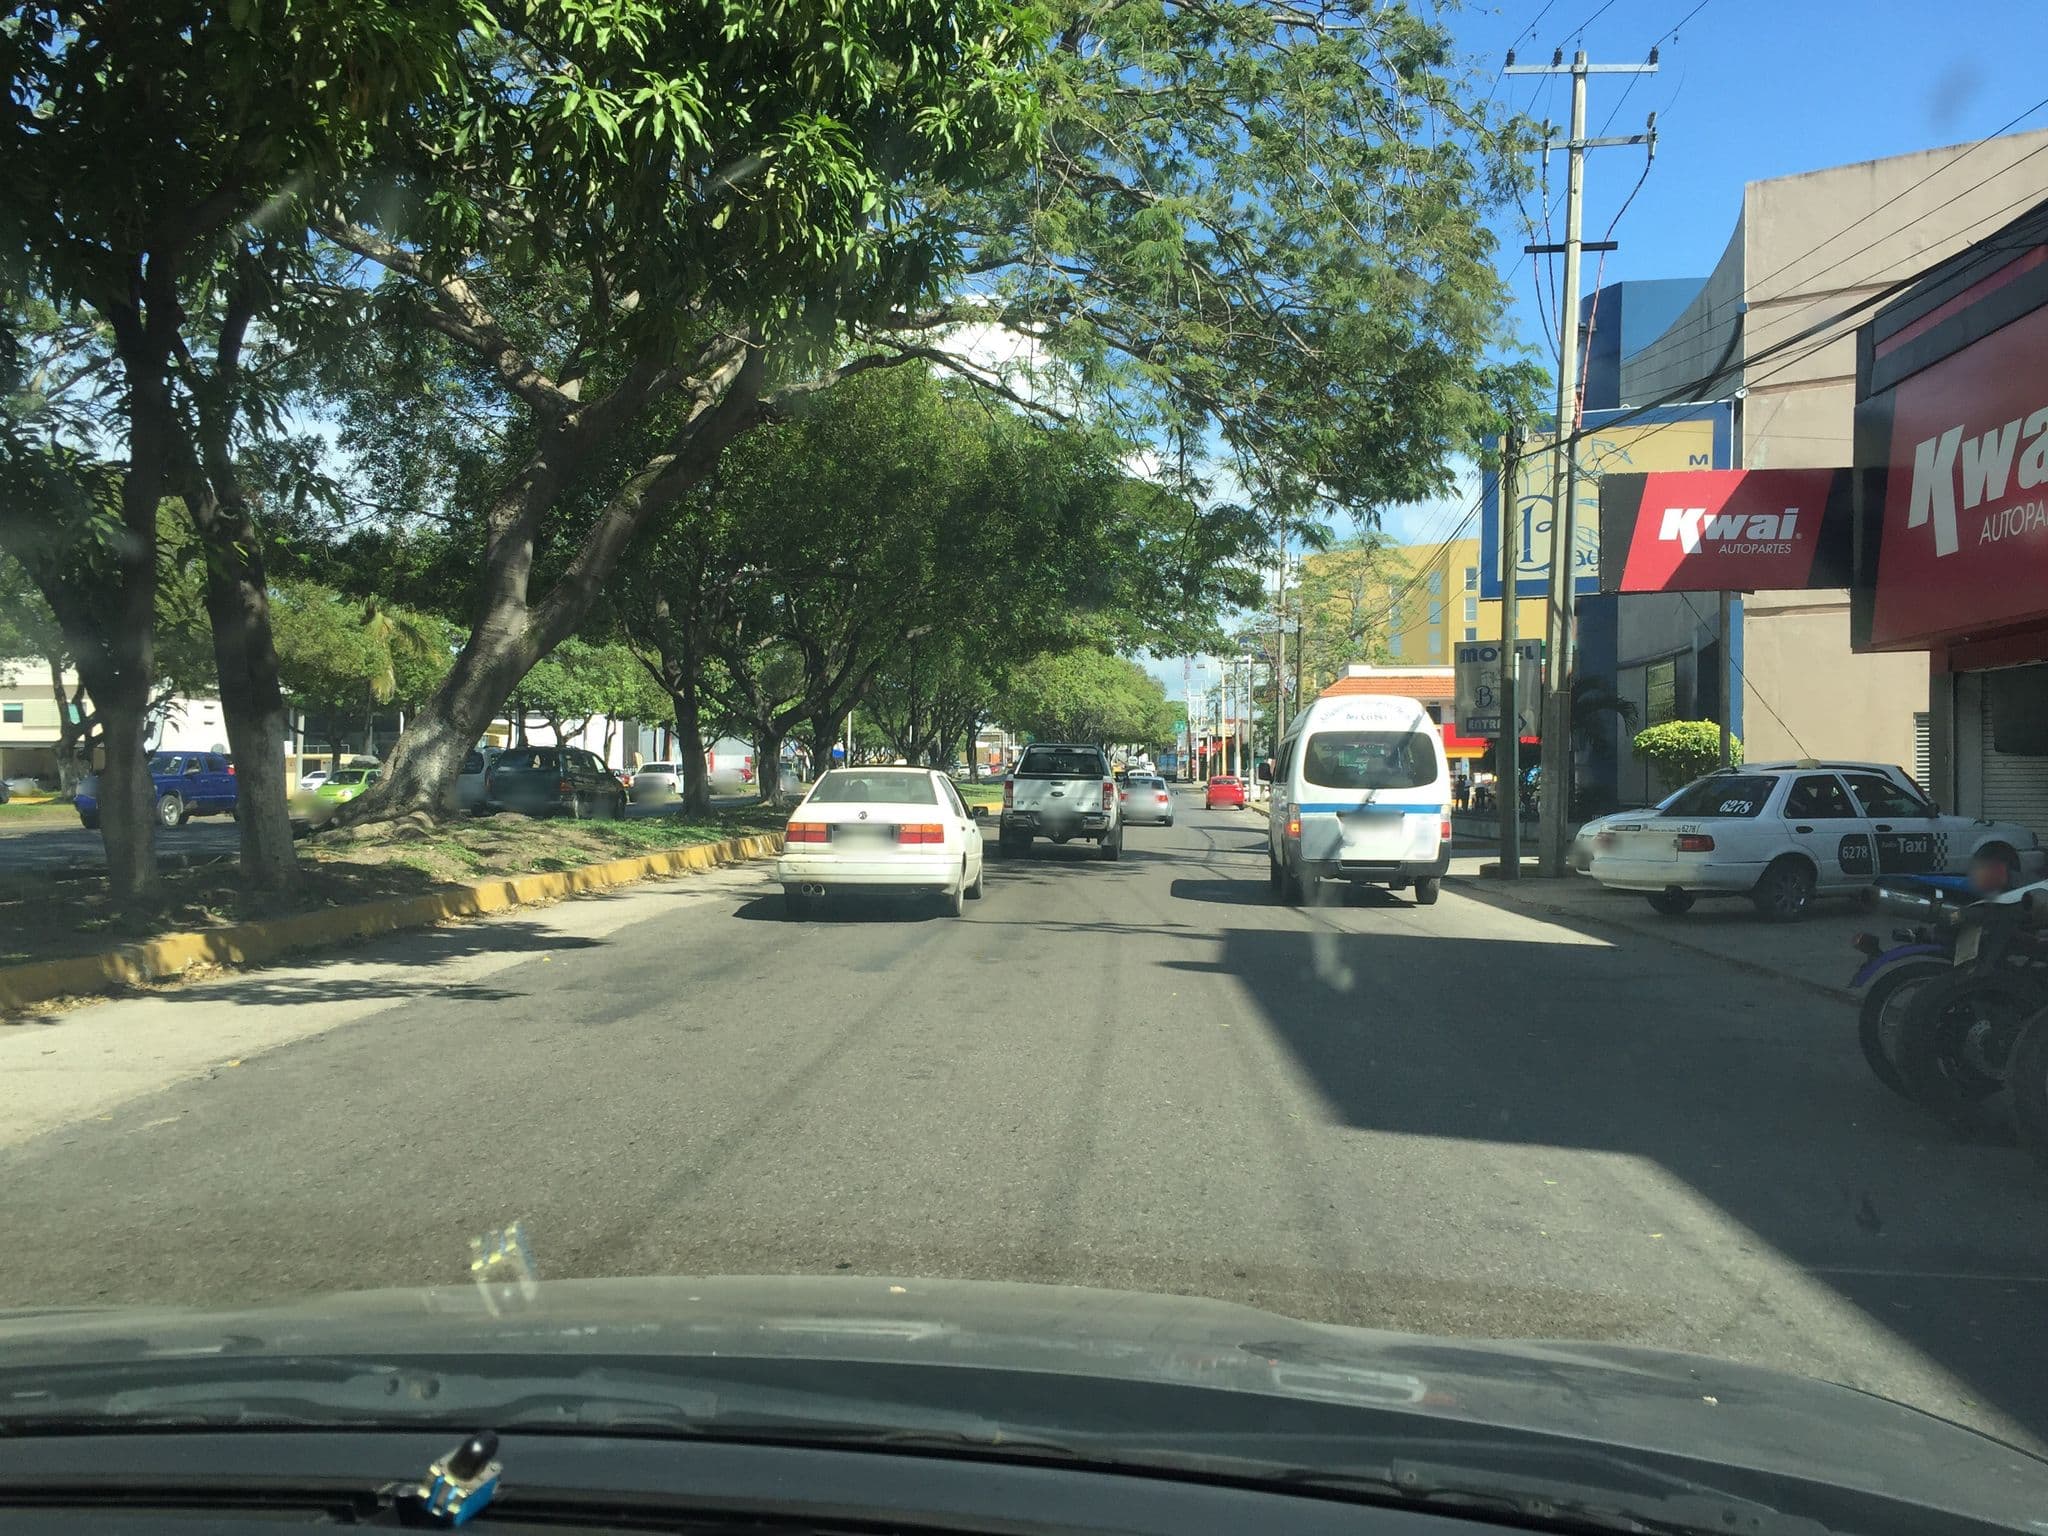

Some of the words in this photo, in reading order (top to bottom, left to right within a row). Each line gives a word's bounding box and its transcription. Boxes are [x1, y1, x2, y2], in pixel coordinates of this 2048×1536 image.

[1658, 507, 1799, 554] Kwai
[1979, 500, 2048, 546] AUTOPA
[1718, 543, 1792, 554] AUTOPARTES
[1461, 645, 1534, 663] MOEL
[1719, 799, 1753, 815] 6278
[1842, 845, 1868, 860] 6278
[1897, 836, 1928, 854] Taxi
